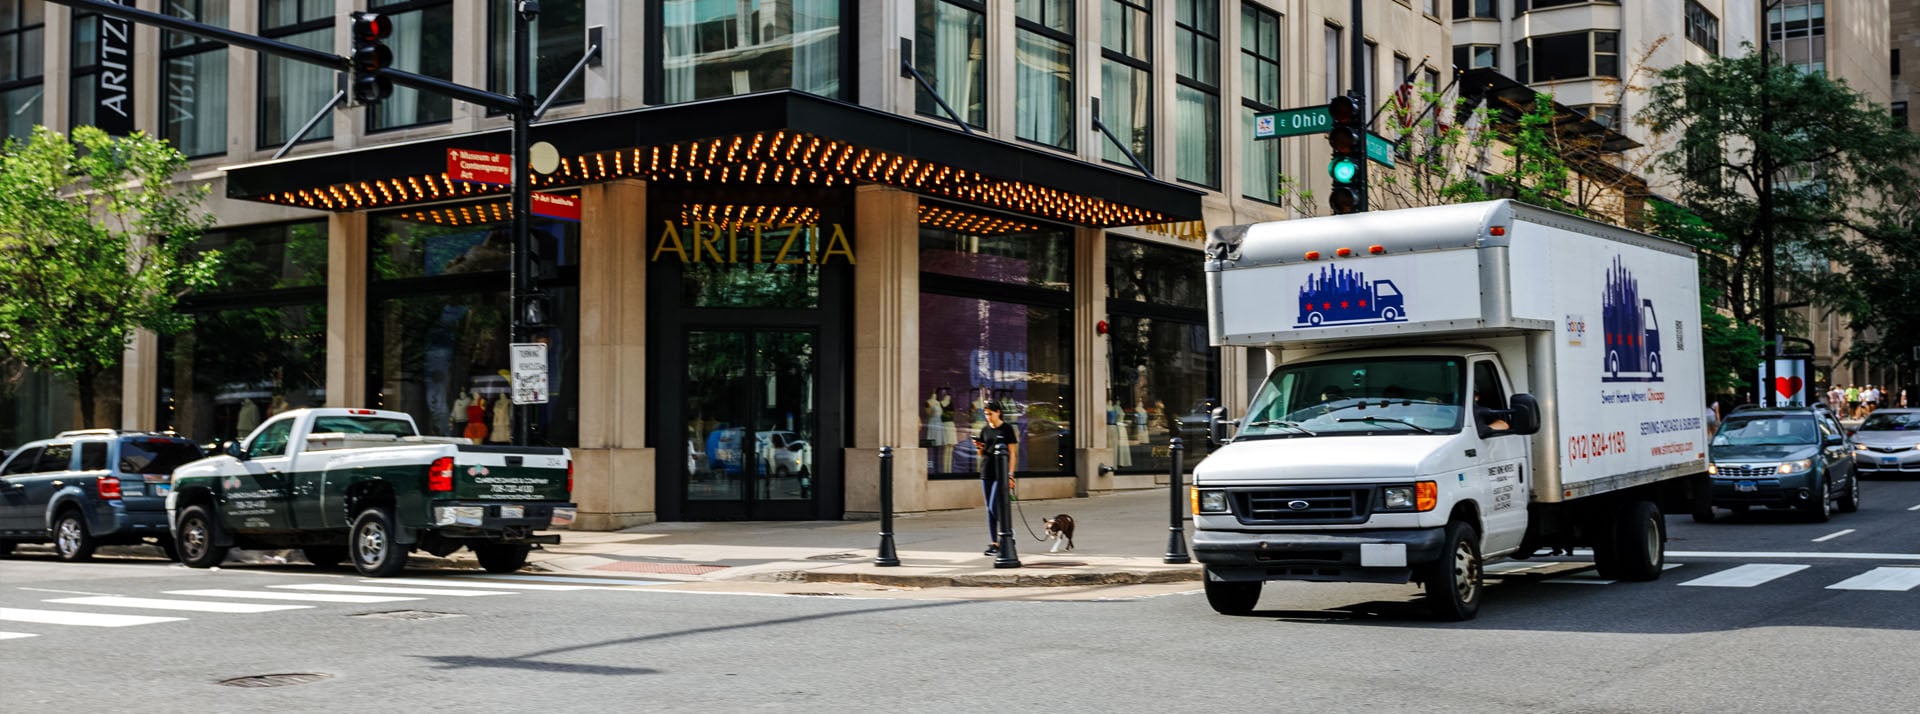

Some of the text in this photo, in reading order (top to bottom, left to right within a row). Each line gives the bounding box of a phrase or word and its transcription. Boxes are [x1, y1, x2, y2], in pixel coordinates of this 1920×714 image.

[101, 0, 128, 118] ARITZ
[1280, 112, 1327, 129] E Ohio
[460, 150, 500, 163] Museum of
[460, 161, 509, 175] Contemporary
[460, 170, 474, 179] Art
[651, 220, 857, 265] ARITZIA
[1566, 314, 1586, 337] Google
[1647, 387, 1665, 404] Chicago
[1568, 431, 1626, 466] (312) 824-1193
